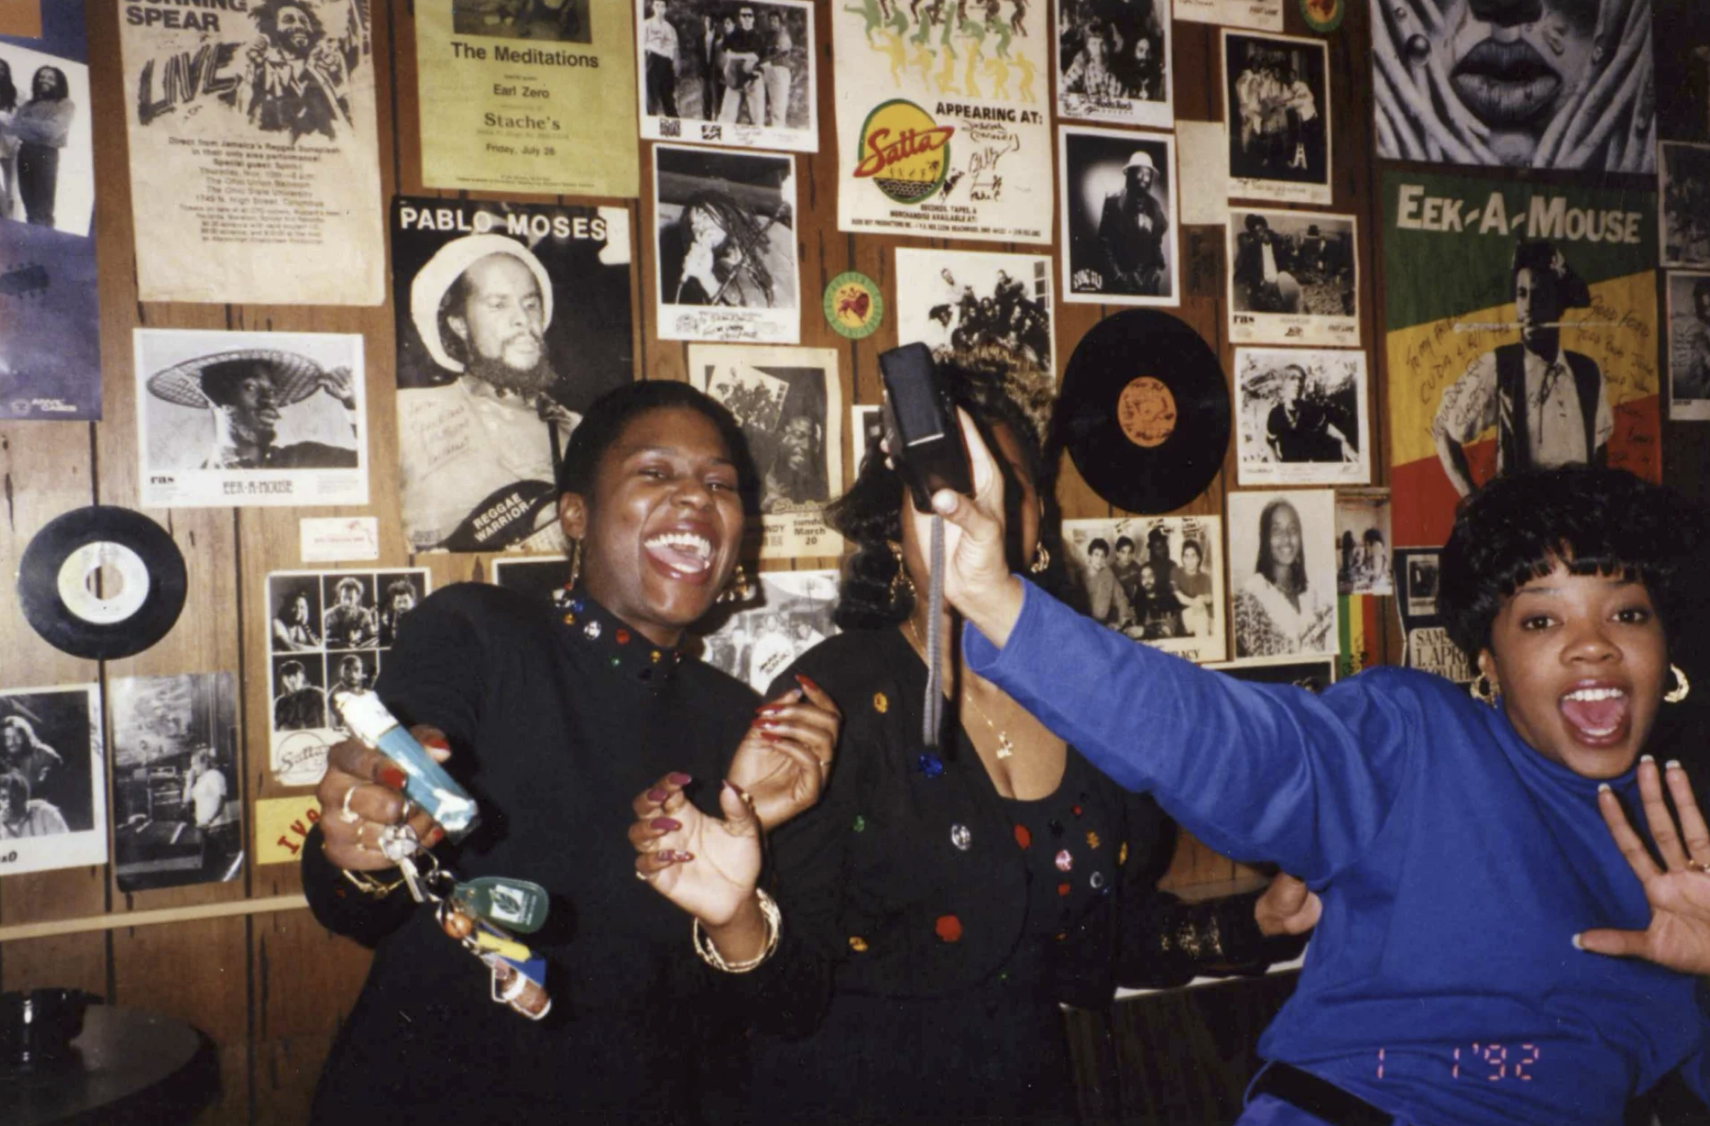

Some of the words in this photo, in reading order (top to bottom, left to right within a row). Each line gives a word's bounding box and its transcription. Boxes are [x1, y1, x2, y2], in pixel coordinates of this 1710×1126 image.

[126, 5, 221, 32] SPEAR
[452, 42, 486, 60] The
[495, 46, 600, 68] Meditations
[138, 41, 246, 126] LIVE
[493, 83, 517, 96] Earl
[522, 86, 550, 99] Zero
[484, 112, 561, 131] Stache's
[936, 102, 1016, 123] APPEARING
[1020, 110, 1043, 125] AT:
[486, 143, 518, 155] Friday,
[521, 146, 540, 156] July
[852, 126, 956, 178] Satta
[400, 207, 493, 233] PABLO
[507, 214, 608, 241] MOSES
[1397, 184, 1642, 244] EEK-A-MOUSE
[150, 476, 175, 485] ras
[473, 492, 523, 530] REGGAE
[474, 502, 530, 542] WARRIOR
[794, 527, 826, 535] March
[805, 536, 818, 545] 20
